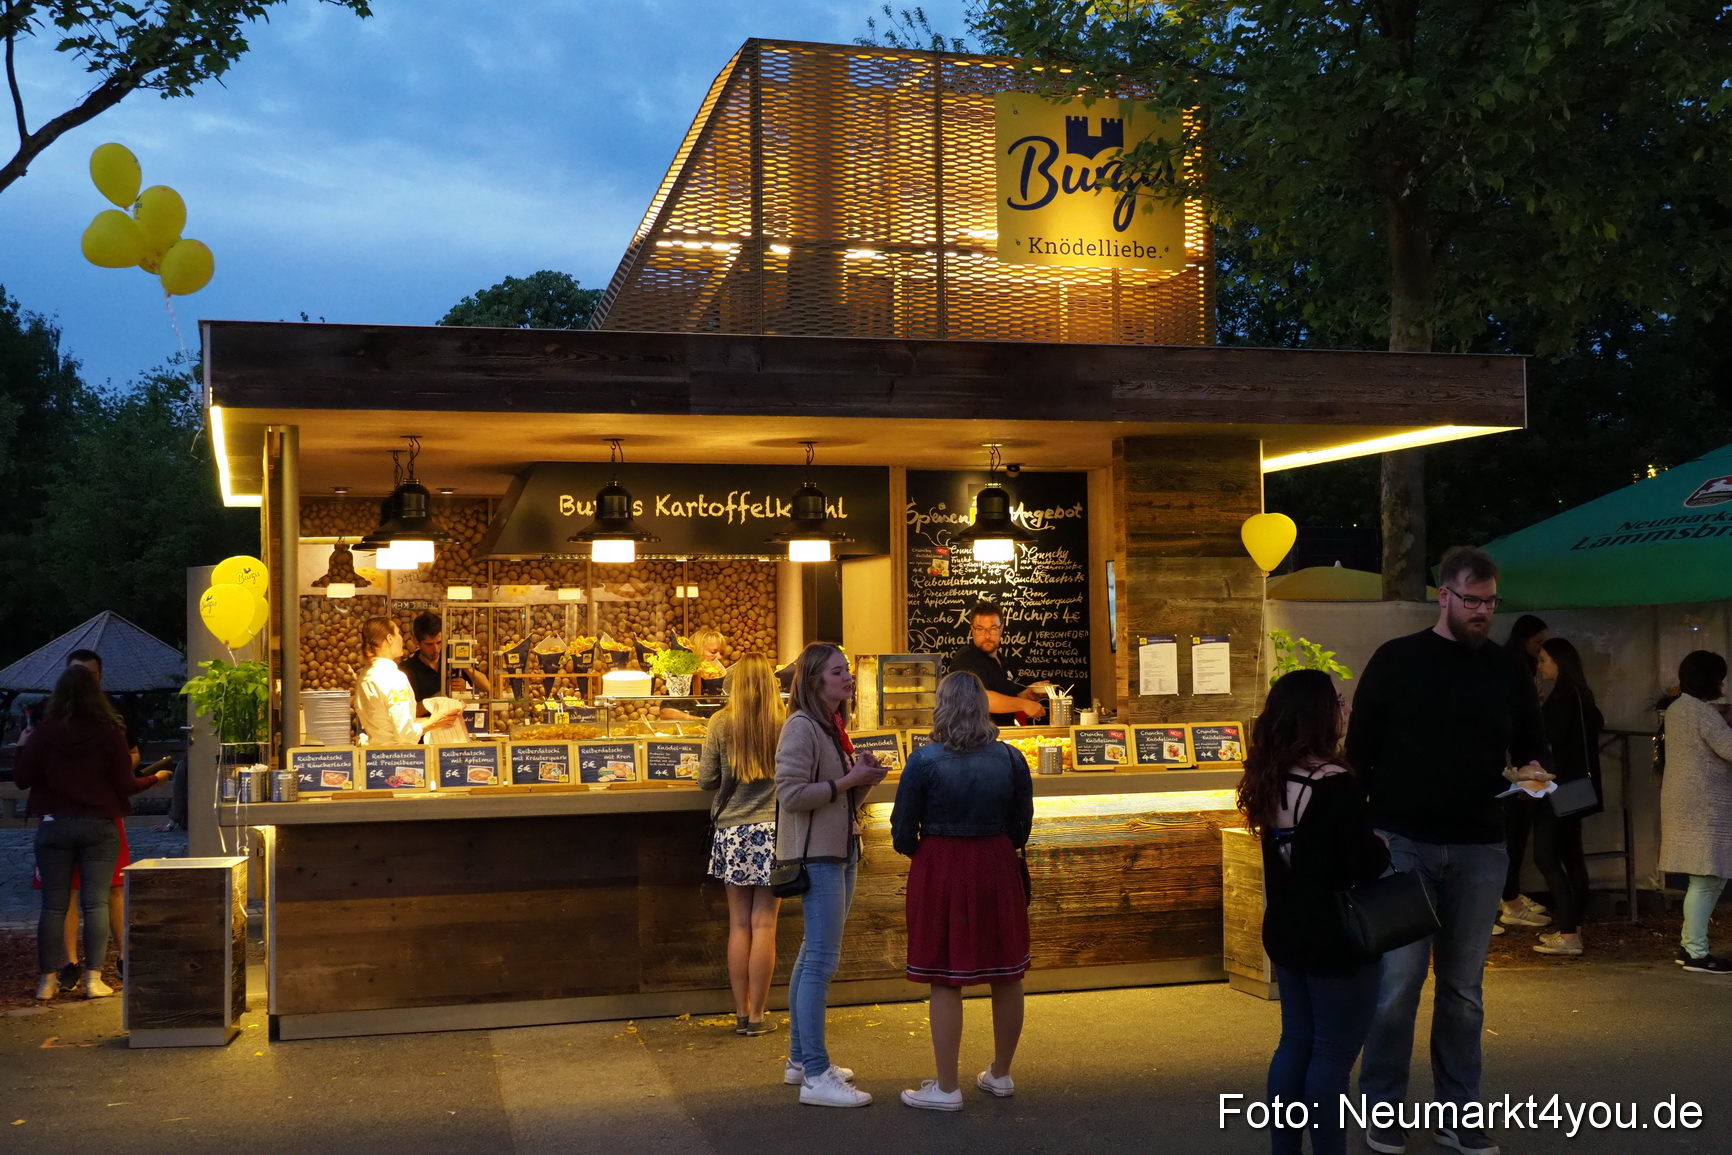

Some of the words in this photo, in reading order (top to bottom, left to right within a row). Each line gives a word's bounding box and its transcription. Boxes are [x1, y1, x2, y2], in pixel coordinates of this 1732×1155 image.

[1029, 237, 1162, 259] Knödelliebe.
[559, 495, 643, 517] Bus
[1617, 511, 1732, 531] Neumark
[517, 764, 532, 773] 5€
[582, 761, 596, 769] 5€
[369, 769, 385, 778] 5€
[445, 769, 460, 778] 5€
[298, 774, 313, 783] 7€
